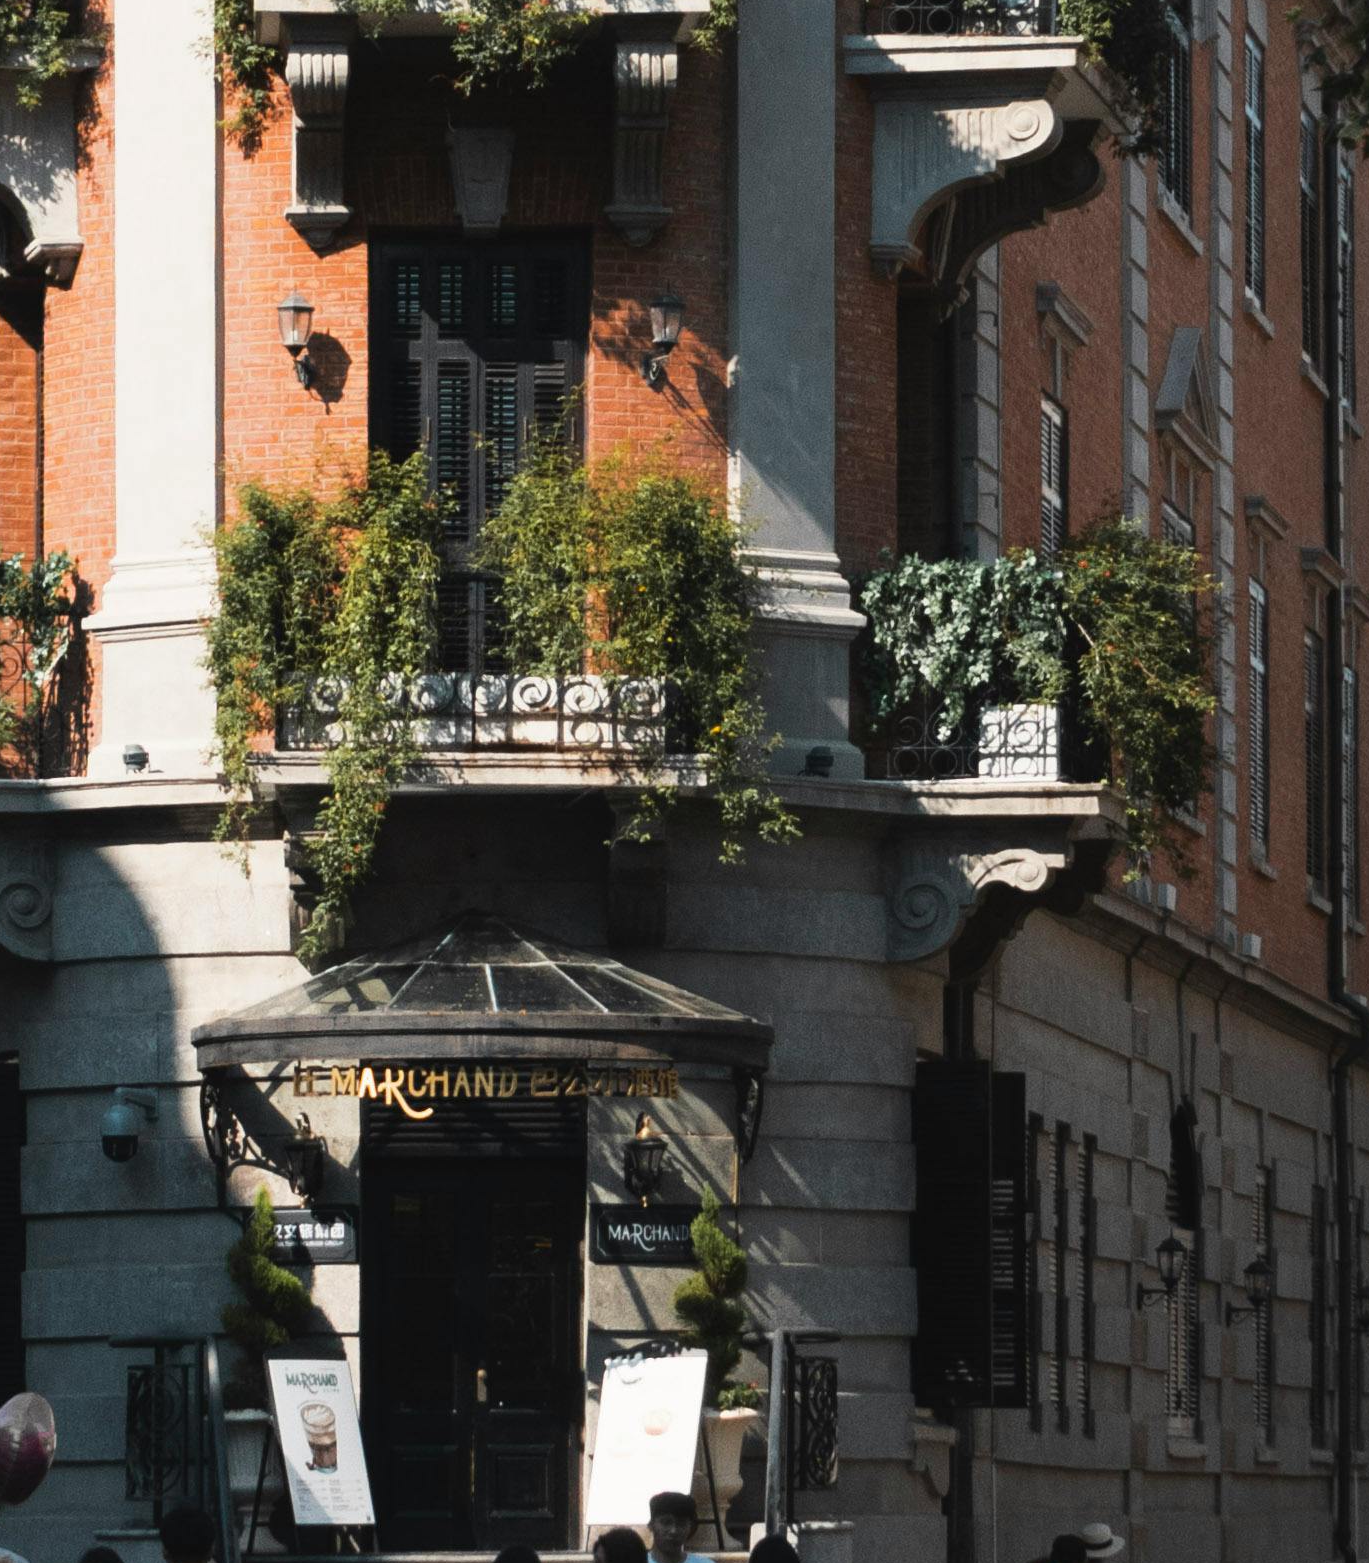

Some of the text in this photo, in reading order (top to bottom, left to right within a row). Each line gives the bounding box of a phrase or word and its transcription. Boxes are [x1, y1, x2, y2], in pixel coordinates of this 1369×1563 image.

[331, 1065, 518, 1119] MARCHAND
[608, 1223, 689, 1251] MARCHAND
[286, 1372, 338, 1394] MARCHAND
